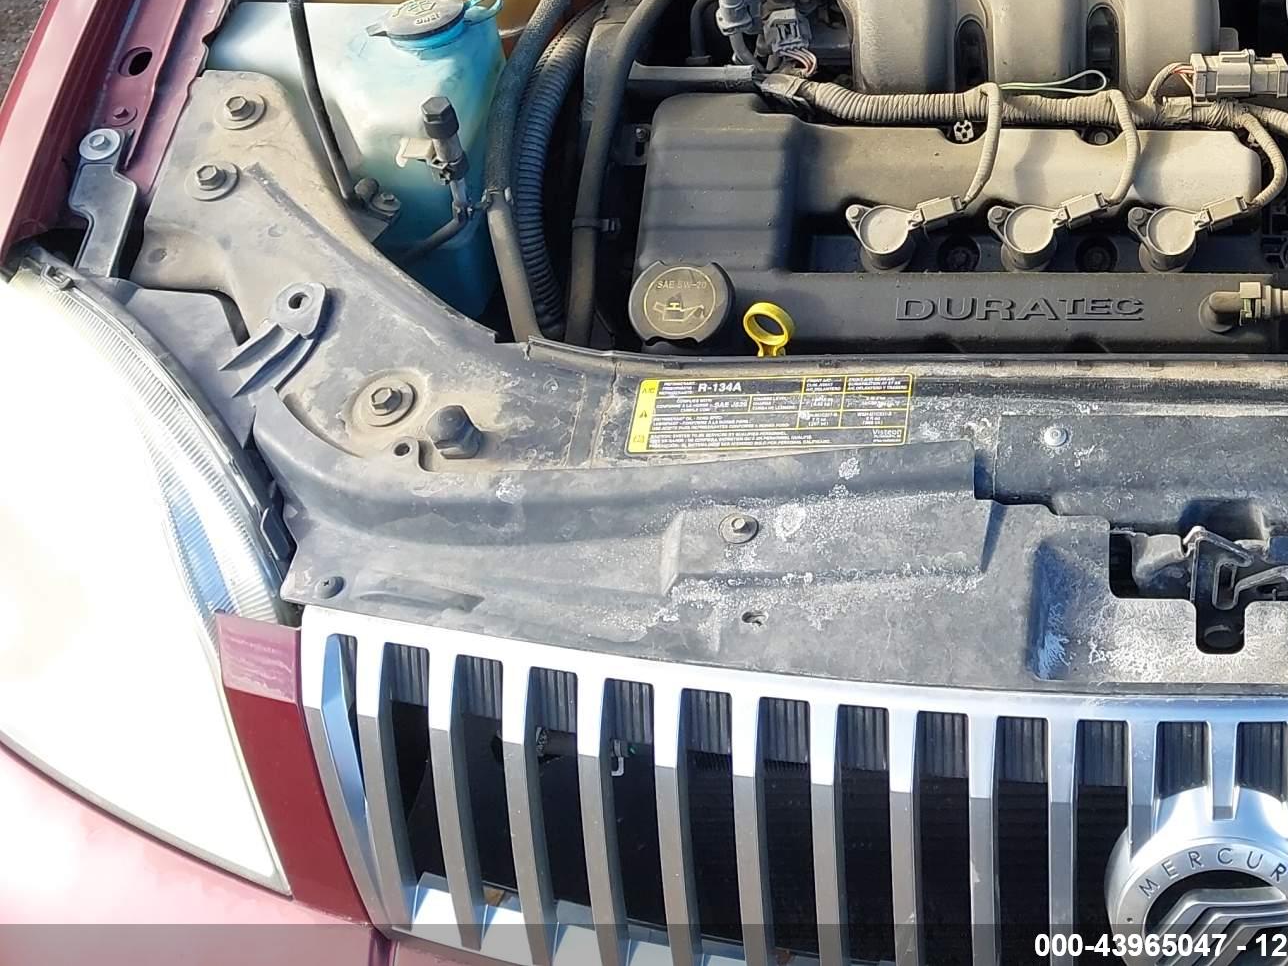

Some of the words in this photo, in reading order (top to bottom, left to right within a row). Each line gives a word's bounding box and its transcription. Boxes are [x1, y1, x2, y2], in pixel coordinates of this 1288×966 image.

[657, 281, 675, 289] SAE
[678, 281, 707, 289] 5W-20
[895, 297, 1145, 321] DURATEC
[697, 382, 742, 392] R-134A
